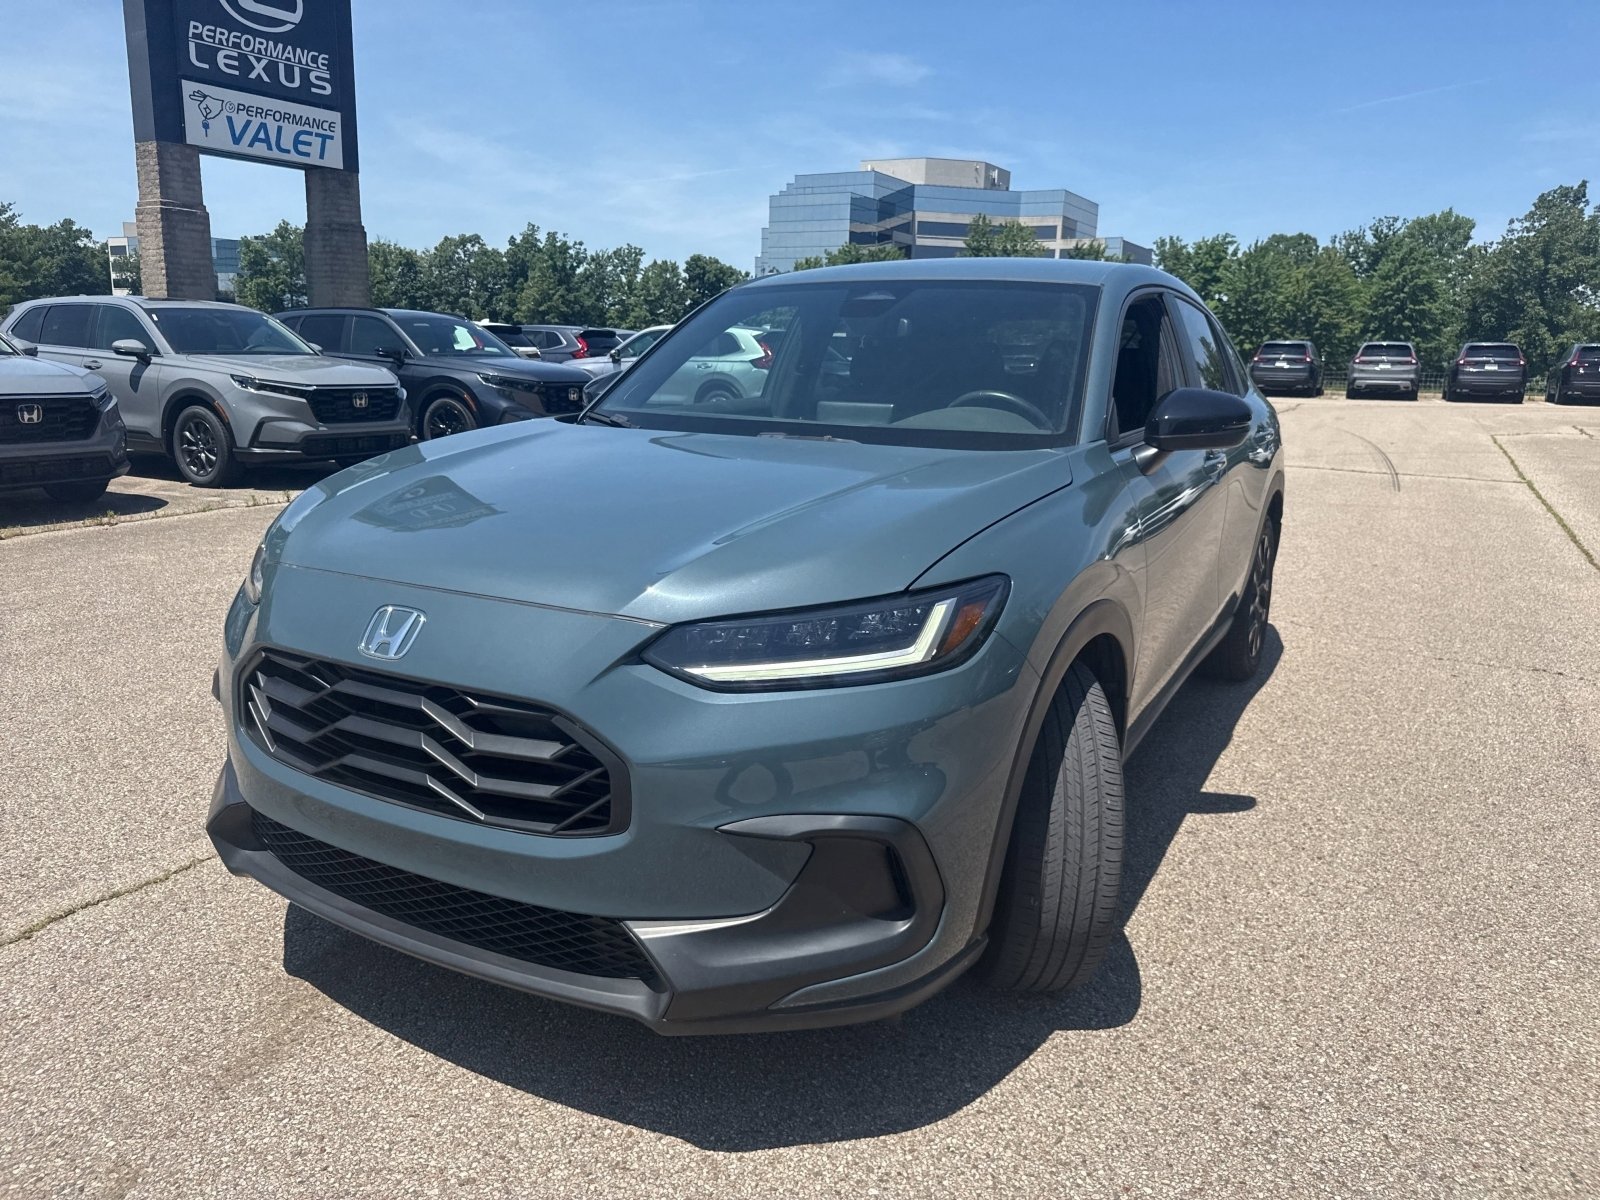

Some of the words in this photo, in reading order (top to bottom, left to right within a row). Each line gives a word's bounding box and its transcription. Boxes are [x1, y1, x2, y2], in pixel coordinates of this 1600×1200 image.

[188, 21, 329, 70] PERFORMANCE
[188, 41, 332, 95] LEXUS
[226, 115, 335, 161] VALET
[236, 103, 337, 133] PERFORMANCE
